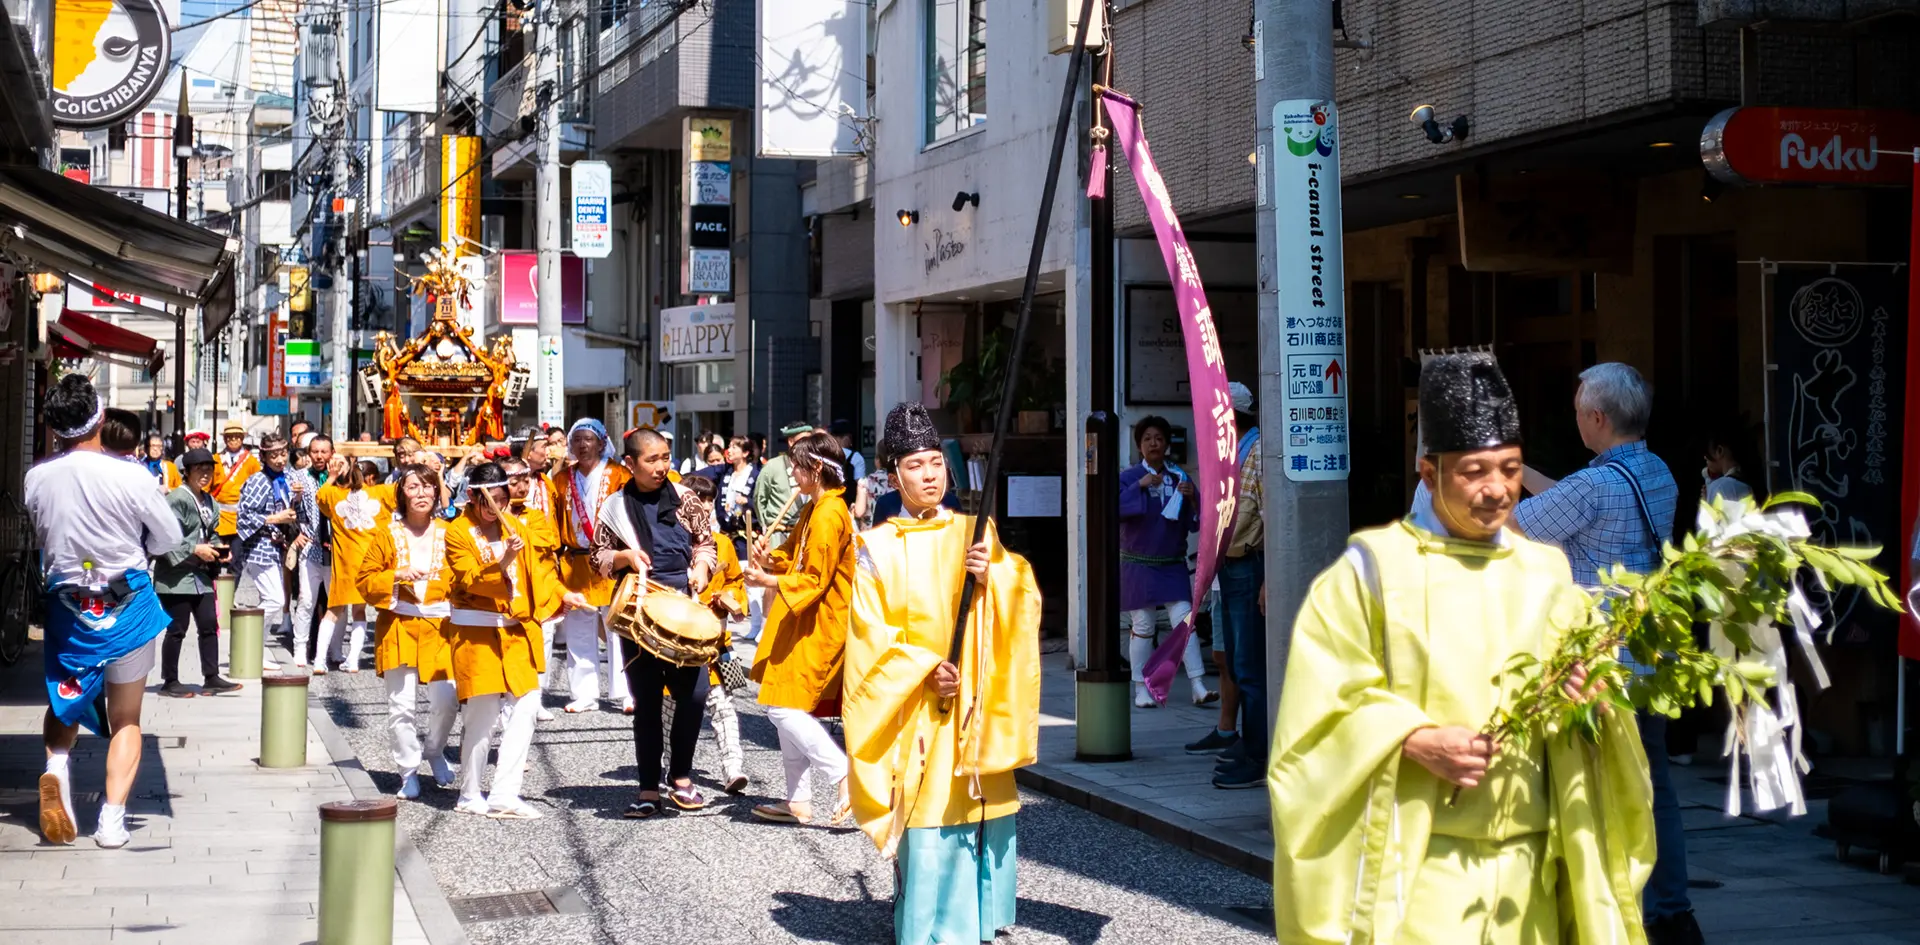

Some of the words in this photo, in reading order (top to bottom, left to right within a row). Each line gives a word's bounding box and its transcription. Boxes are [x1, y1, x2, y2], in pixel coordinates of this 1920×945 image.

[1308, 162, 1325, 237] i-canal
[577, 205, 605, 215] DENTAL
[577, 214, 601, 223] CLINIC
[695, 222, 727, 232] FACE.
[694, 260, 728, 271] HAPPY
[693, 271, 728, 281] BRAND
[1310, 244, 1326, 308] street
[671, 323, 734, 356] HAPPY
[1292, 380, 1324, 395] 山下公園
[1290, 454, 1347, 472] 車に注意
